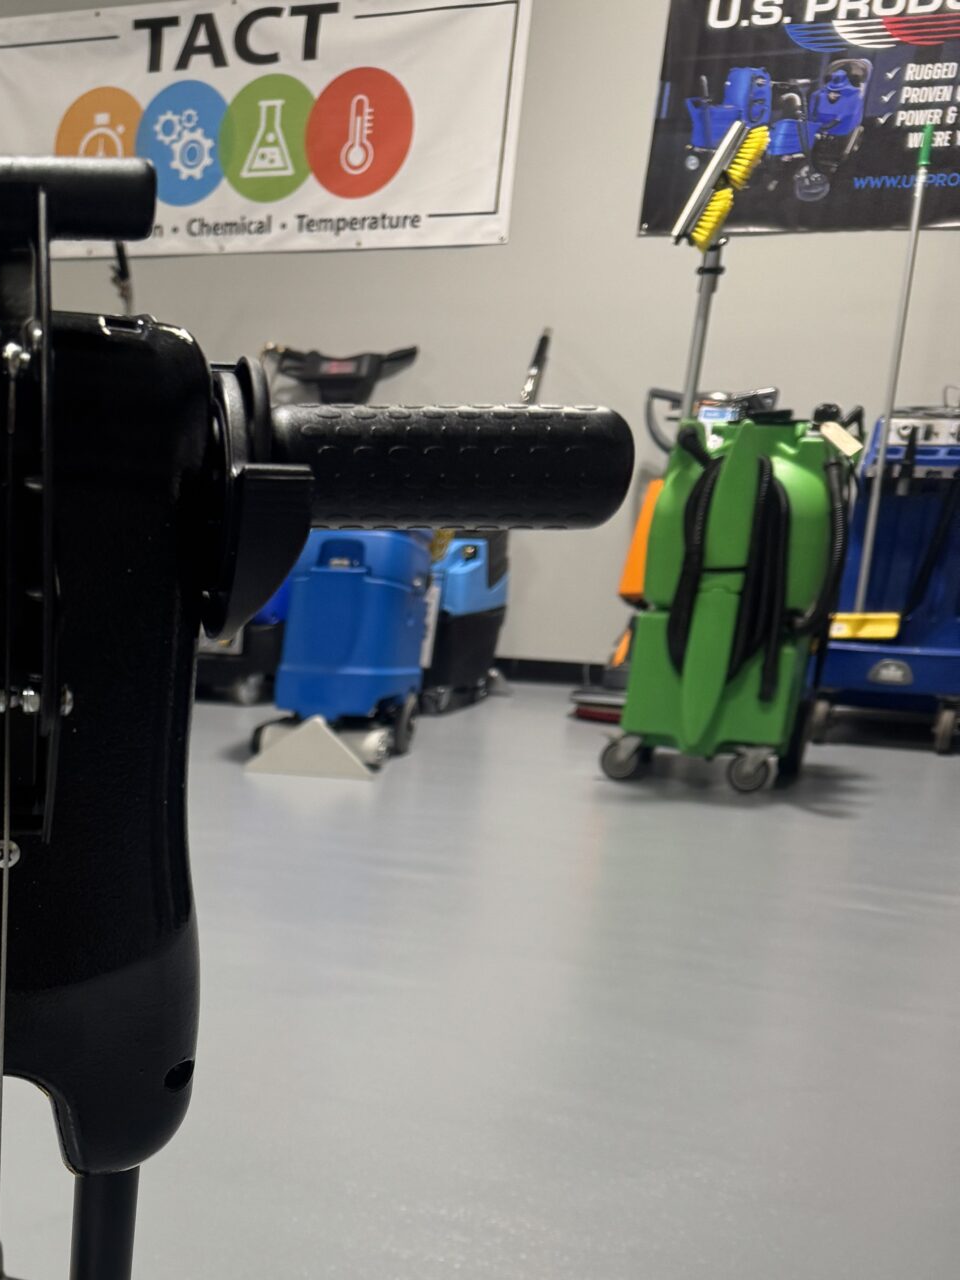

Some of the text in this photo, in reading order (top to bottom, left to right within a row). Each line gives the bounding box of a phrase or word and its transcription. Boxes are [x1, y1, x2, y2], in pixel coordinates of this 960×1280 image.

[133, 2, 339, 73] TACT
[905, 62, 958, 81] RUGGED
[900, 85, 954, 104] PROVEN
[896, 109, 943, 126] POWER
[186, 215, 273, 237] Chemical
[296, 212, 422, 236] Temperature
